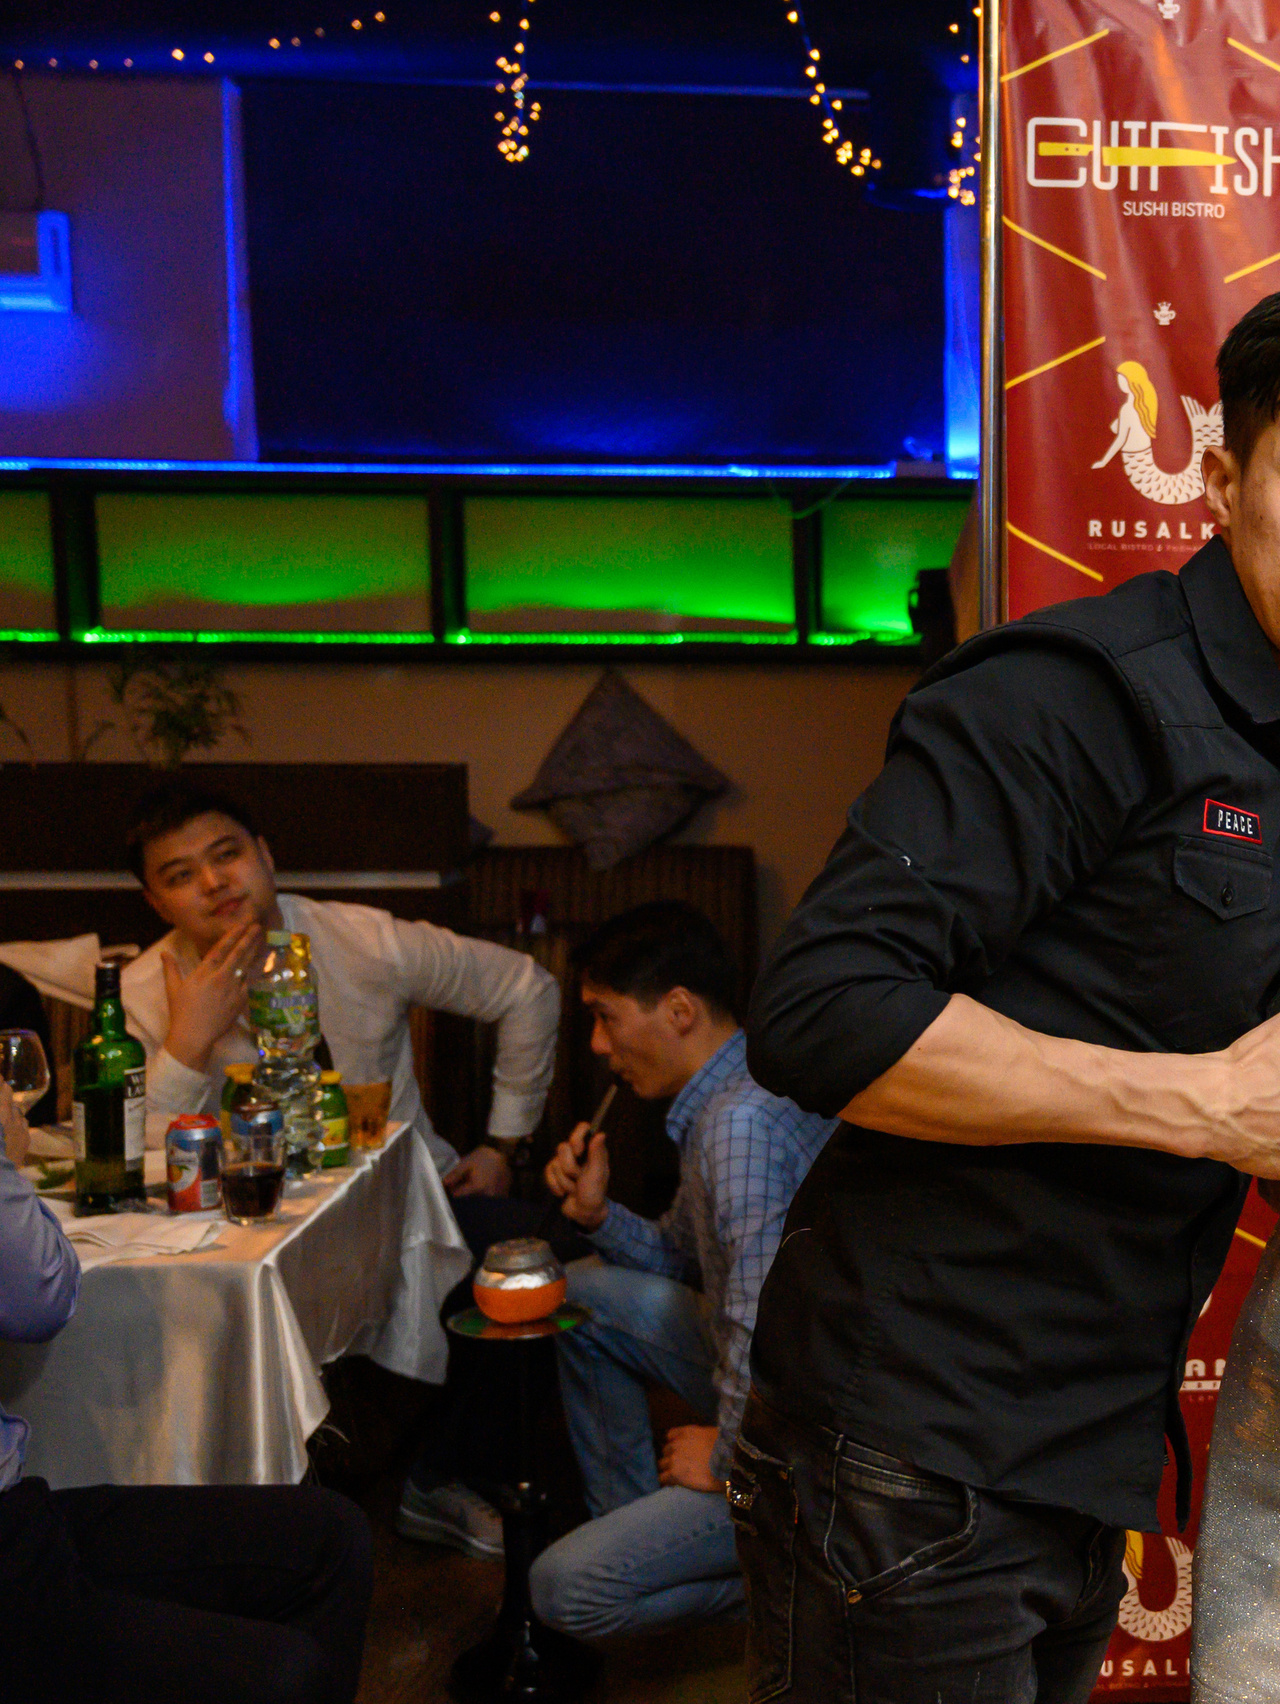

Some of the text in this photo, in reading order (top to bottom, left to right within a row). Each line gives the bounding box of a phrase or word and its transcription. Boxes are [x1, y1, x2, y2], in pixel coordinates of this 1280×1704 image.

[1123, 201, 1225, 219] SUSHI BISTRO
[1088, 520, 1216, 540] RUSALK
[1217, 809, 1254, 835] PEACE
[1100, 1658, 1190, 1677] USAL
